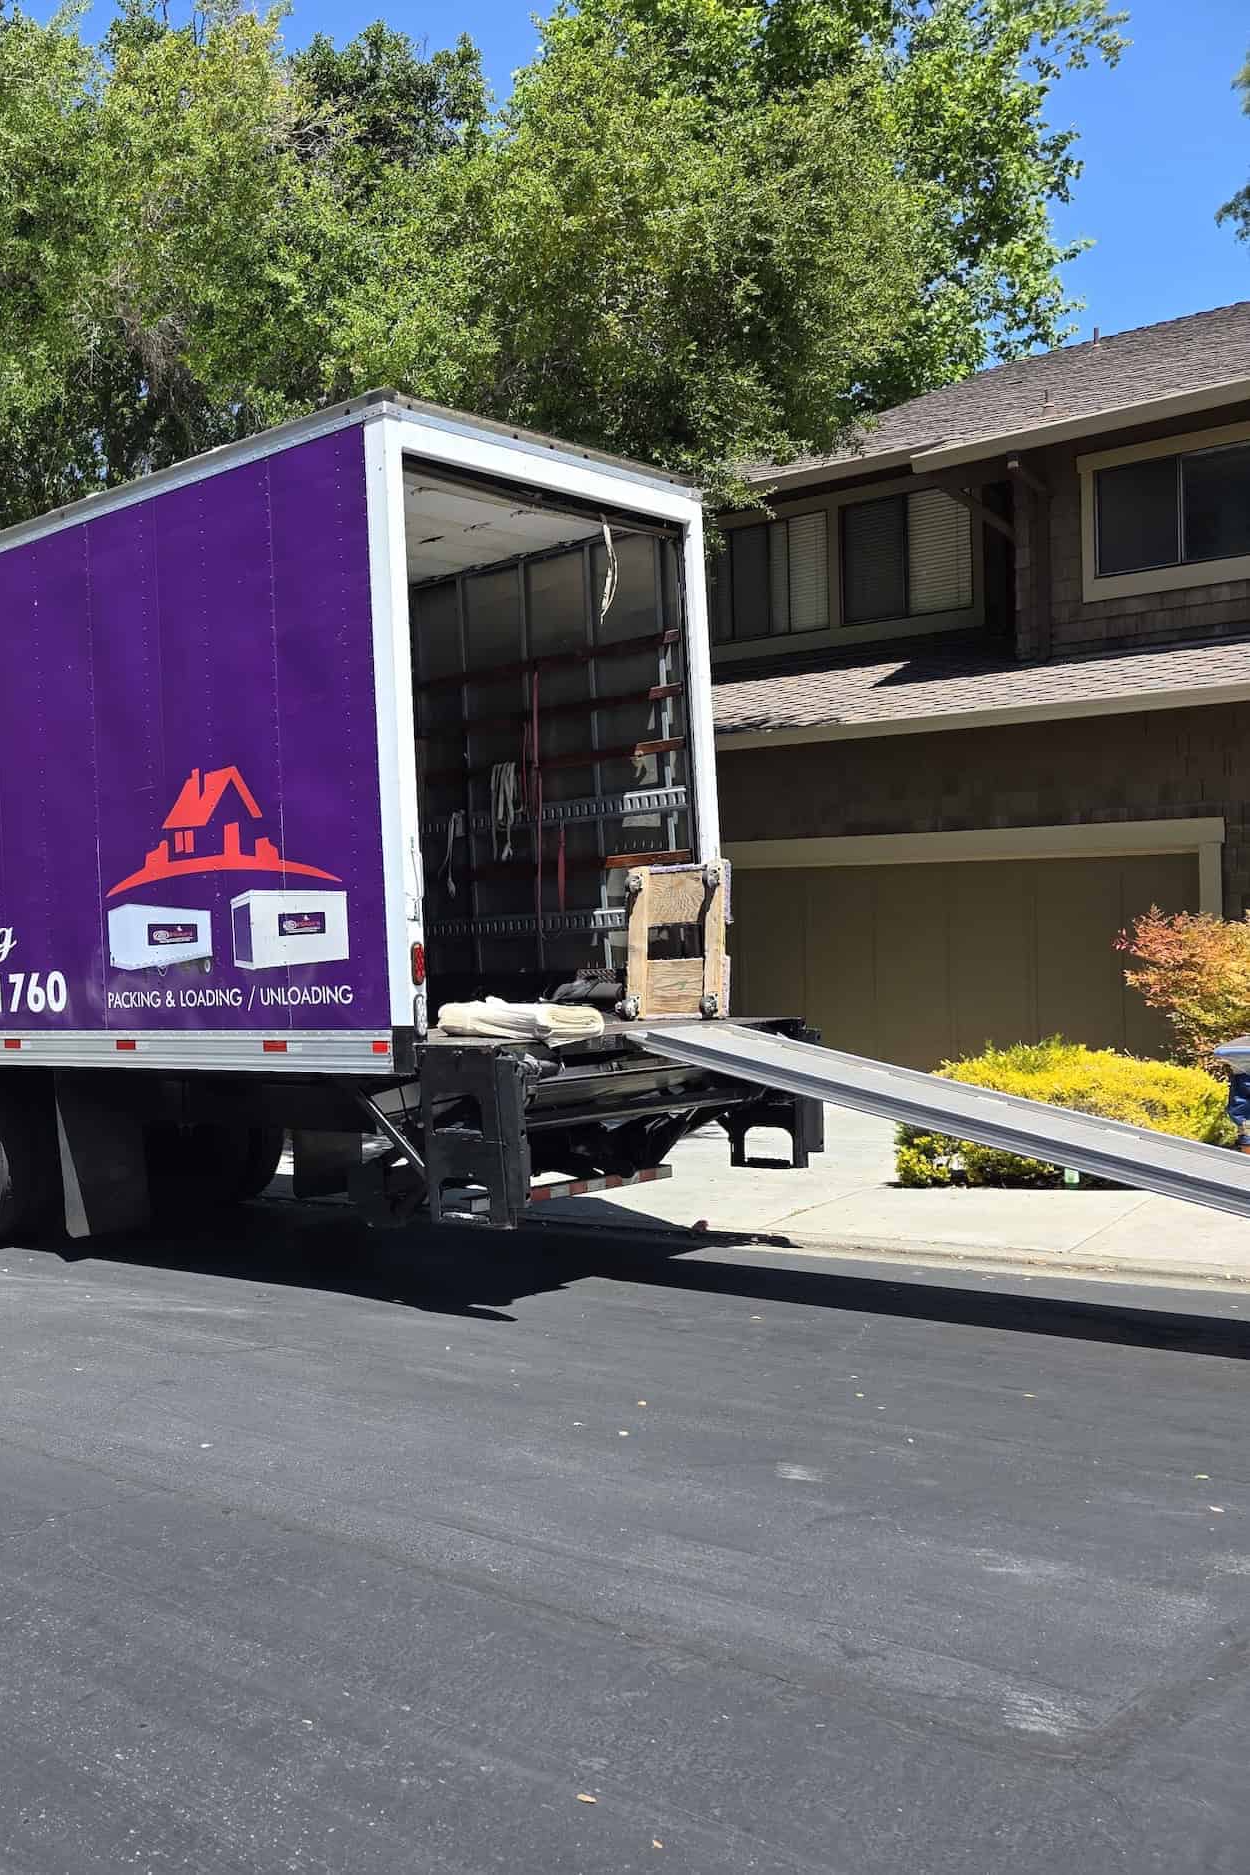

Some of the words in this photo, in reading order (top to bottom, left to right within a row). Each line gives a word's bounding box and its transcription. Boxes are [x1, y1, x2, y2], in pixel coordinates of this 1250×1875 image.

[107, 990, 161, 1009] PACKING
[165, 990, 176, 1008] &
[180, 988, 243, 1008] LOADING
[247, 985, 256, 1011] /
[261, 985, 354, 1006] UNLOADING
